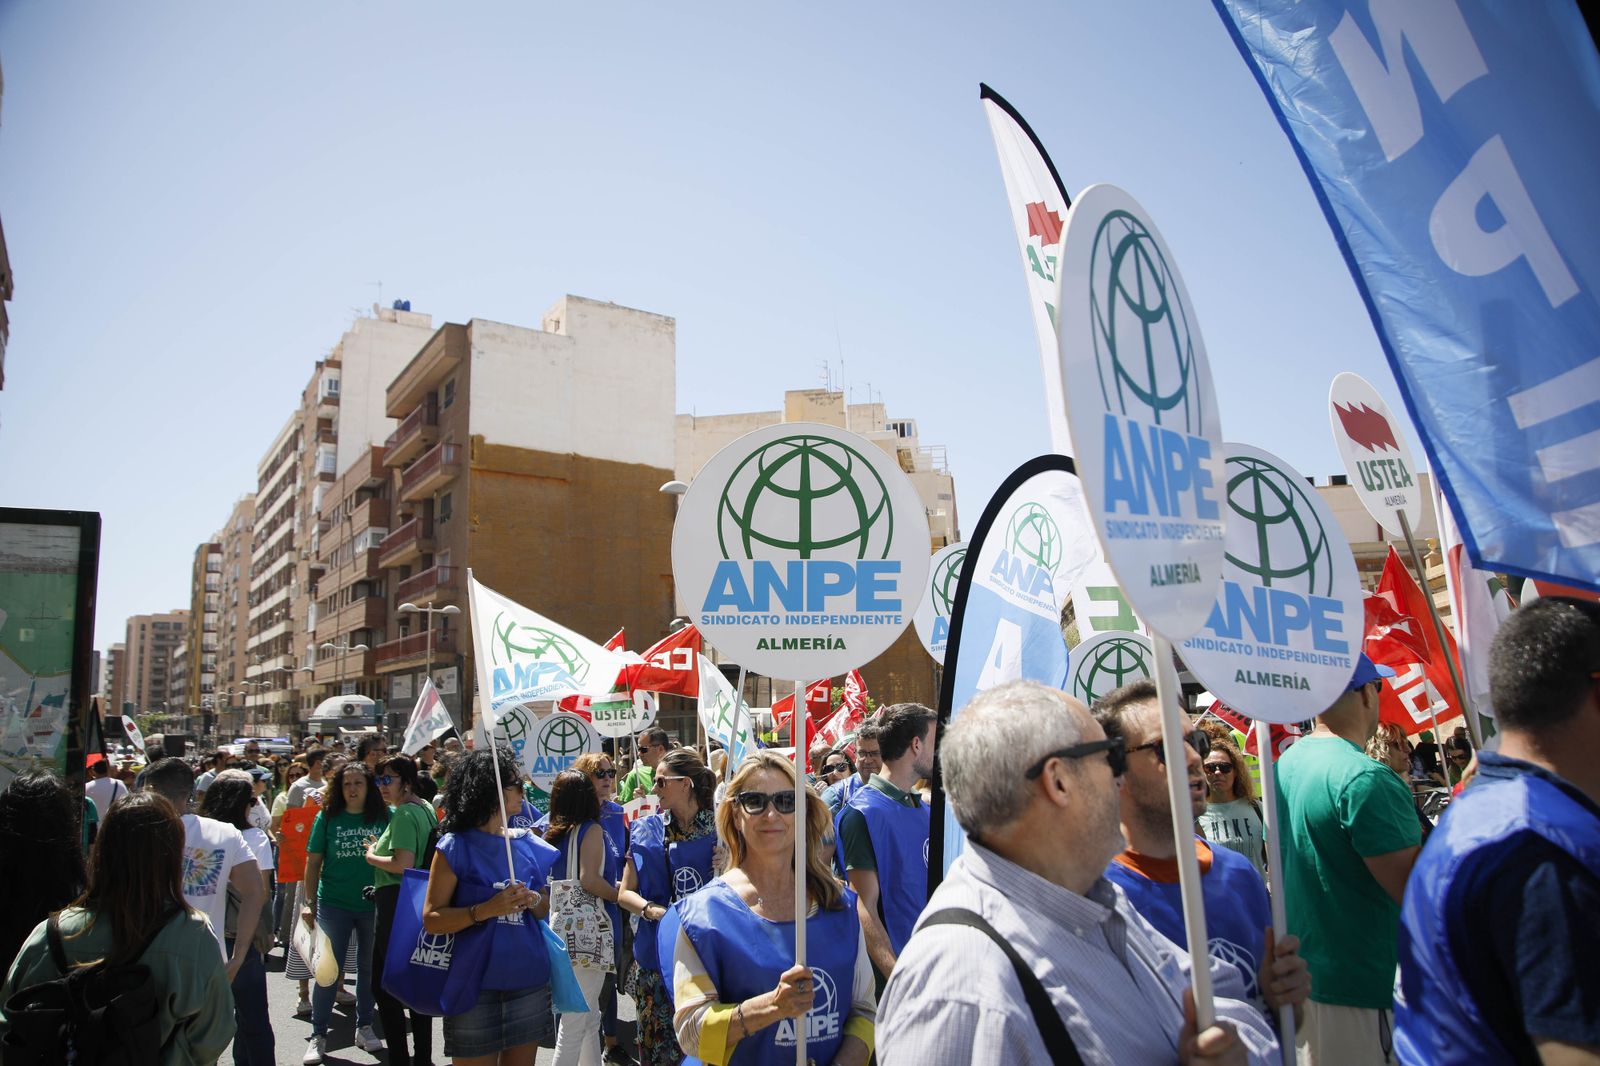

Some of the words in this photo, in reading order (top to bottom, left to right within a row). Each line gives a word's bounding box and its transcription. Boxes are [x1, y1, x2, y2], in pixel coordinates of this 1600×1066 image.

[1104, 413, 1220, 520] ANPE
[1356, 458, 1414, 492] USTEA
[1105, 519, 1160, 540] SINDICATO
[1161, 522, 1224, 541] INDEPENDIENTE
[991, 549, 1055, 597] ANP
[1151, 556, 1202, 588] ALMERÍA
[701, 560, 902, 613] ANPE
[701, 615, 780, 625] SINDICATO
[785, 615, 902, 625] INDEPENDIENTE
[756, 634, 846, 650] ALMERÍA
[1184, 638, 1253, 656] SINDICATO
[1257, 645, 1351, 669] INDEPENDIENTE
[1235, 669, 1312, 691] ALMERÍA
[595, 709, 637, 720] USTEA
[1211, 817, 1253, 840] NIKE
[410, 947, 452, 967] ANPE
